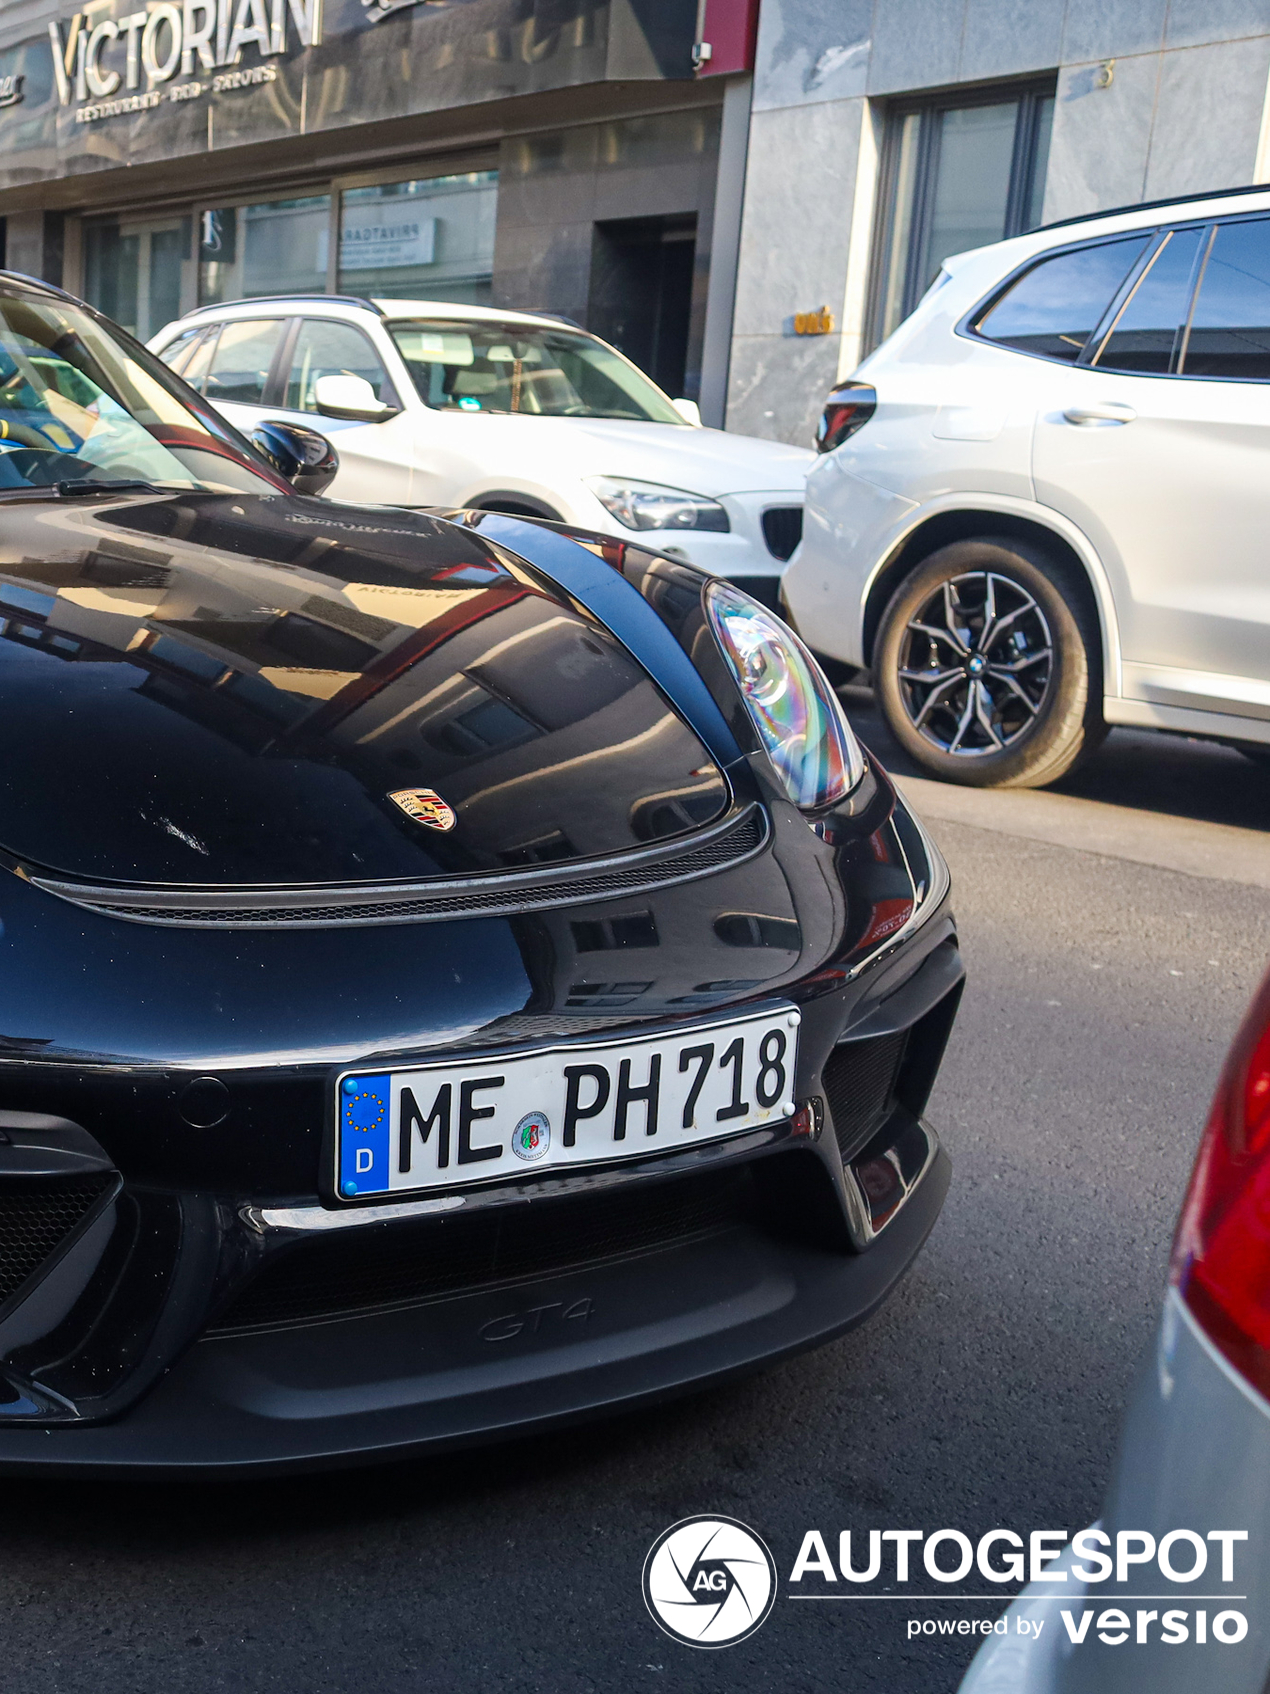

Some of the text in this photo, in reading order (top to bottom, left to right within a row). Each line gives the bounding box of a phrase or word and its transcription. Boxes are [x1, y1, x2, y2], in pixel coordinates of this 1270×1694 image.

[48, 0, 323, 105] VICTORIAN
[1097, 58, 1115, 88] 3
[76, 90, 160, 123] RESTAURANT
[213, 64, 278, 92] SALONS
[355, 1028, 787, 1174] D ME PH 718
[479, 1298, 596, 1341] GT4
